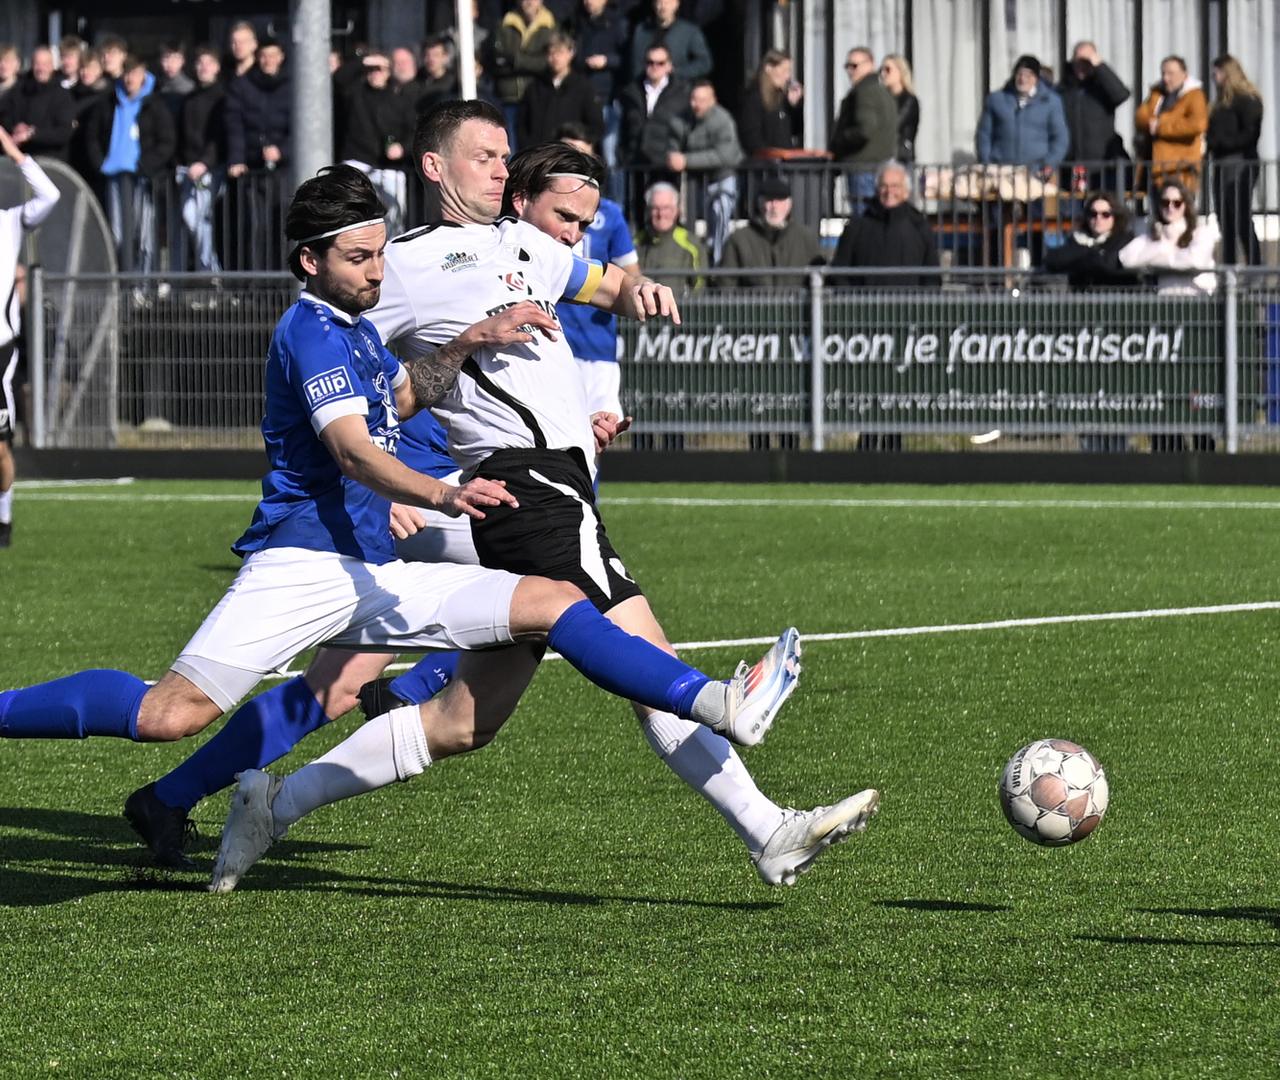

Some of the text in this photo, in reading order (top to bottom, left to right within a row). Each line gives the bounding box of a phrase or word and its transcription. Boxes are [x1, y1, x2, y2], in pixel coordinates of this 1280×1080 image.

[634, 324, 780, 363] Marken
[897, 323, 939, 373] je
[946, 324, 1184, 374] fantastisch!
[1012, 743, 1036, 789] BYSTAR
